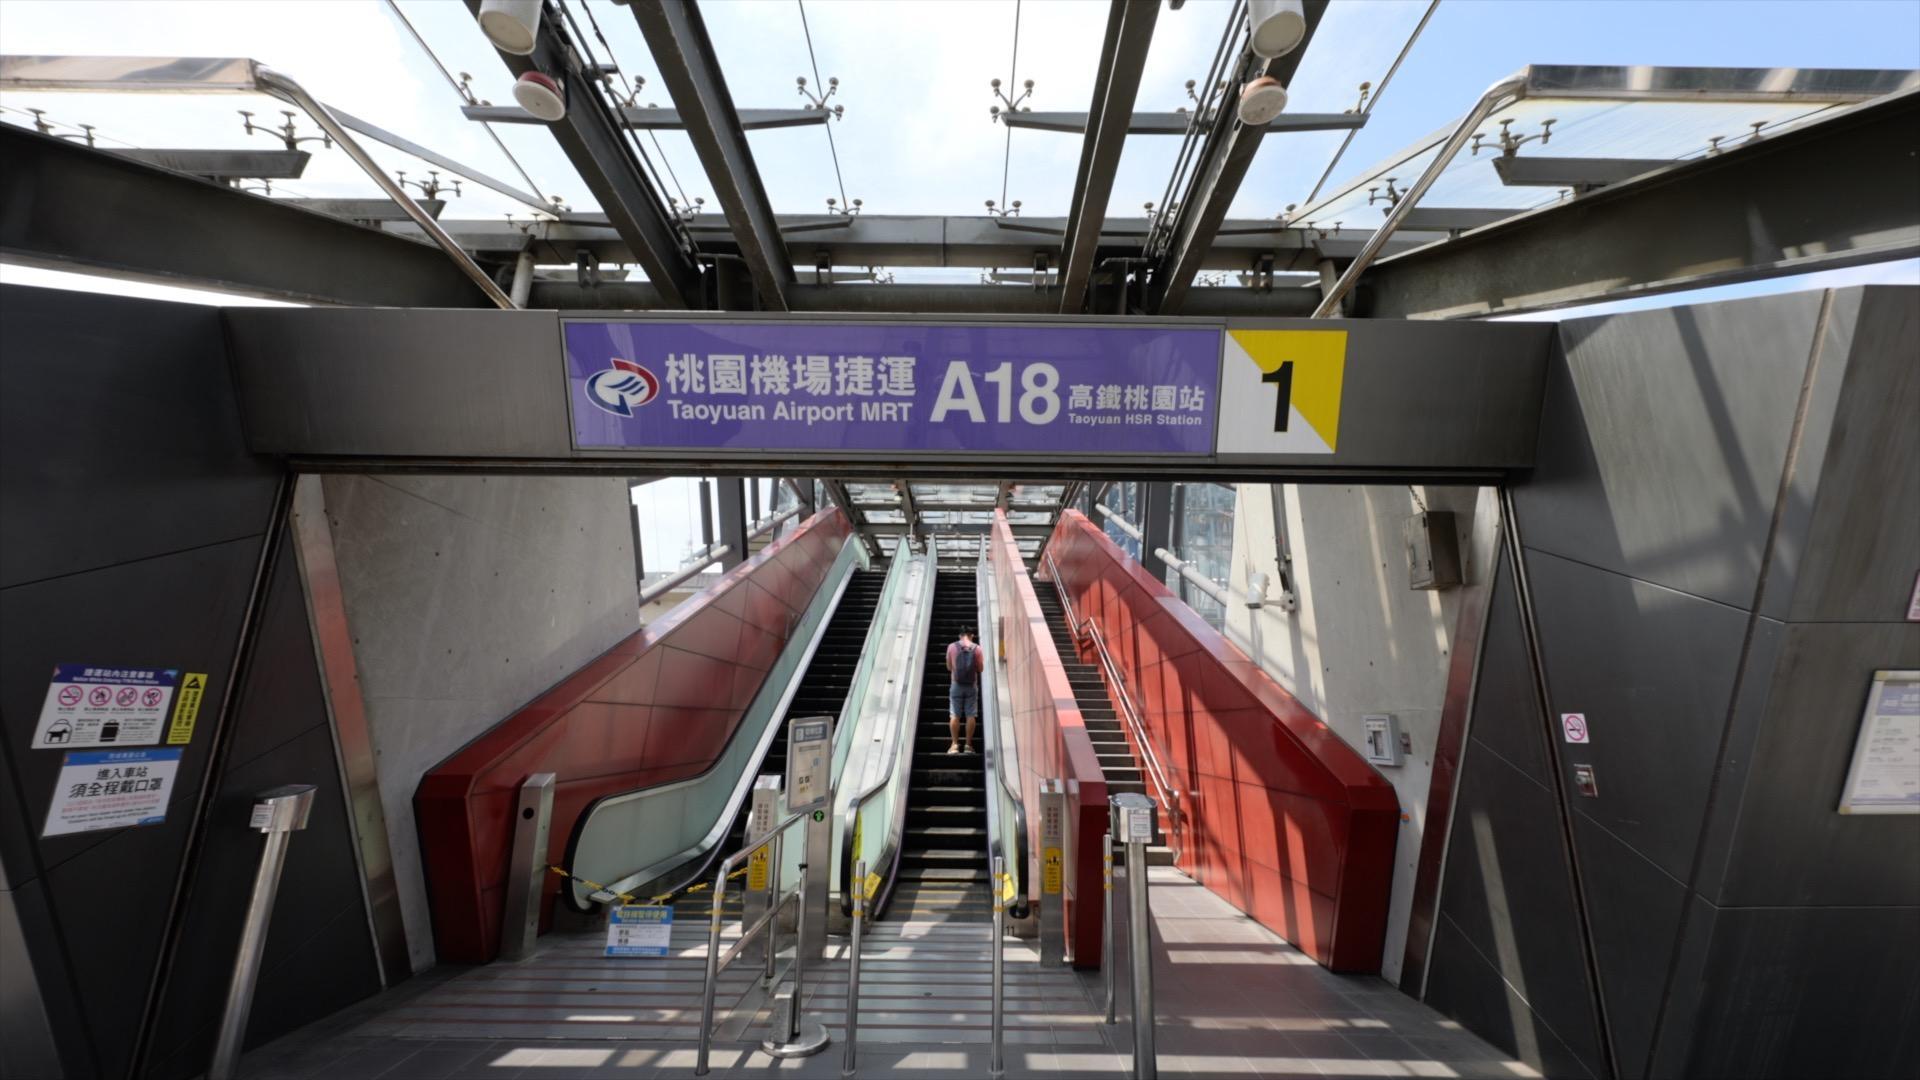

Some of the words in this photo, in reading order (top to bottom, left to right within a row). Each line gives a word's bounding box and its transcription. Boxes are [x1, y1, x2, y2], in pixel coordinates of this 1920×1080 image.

[665, 353, 916, 396] 桃園機場捷運
[929, 361, 1060, 425] A18
[1068, 384, 1205, 412] 高鐵桃園站
[1262, 361, 1294, 432] 1
[667, 400, 765, 424] Taoyuan
[773, 401, 853, 425] Airport
[861, 402, 912, 421] MRT
[1068, 413, 1120, 426] Taoyuan
[1125, 414, 1152, 425] HSR
[1156, 414, 1202, 425] Station
[96, 766, 148, 780] 進入車站
[68, 777, 163, 798] 須全程戴口罩
